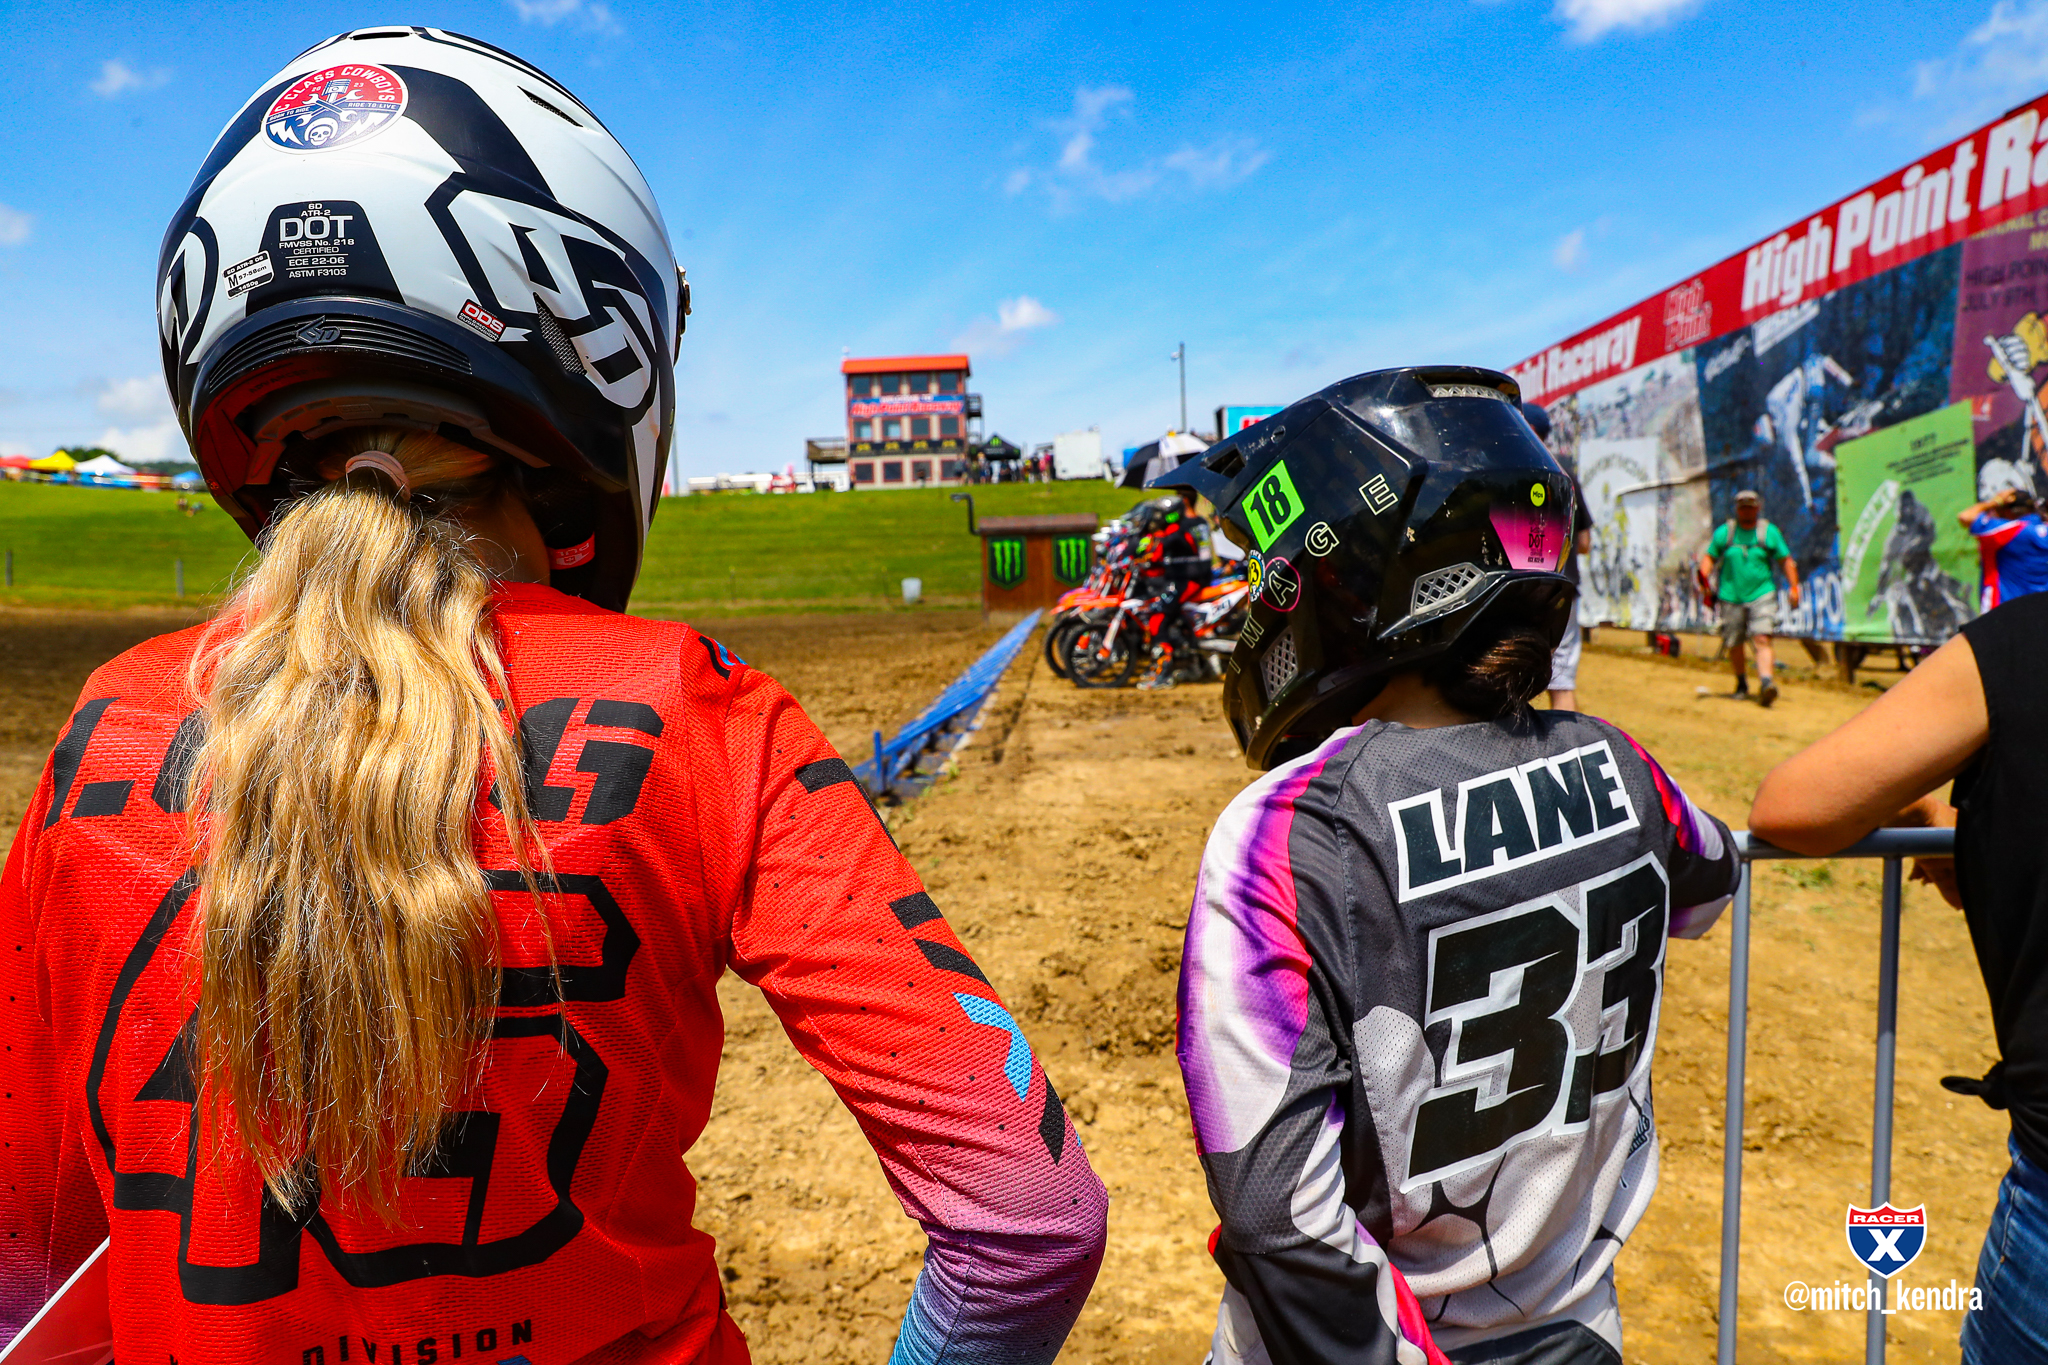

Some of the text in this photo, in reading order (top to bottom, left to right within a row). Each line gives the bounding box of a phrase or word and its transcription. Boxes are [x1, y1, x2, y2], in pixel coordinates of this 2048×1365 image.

[274, 66, 396, 112] C CLASS COWBOYS
[300, 209, 331, 217] ATR-2
[1741, 215, 1832, 312] High
[1832, 140, 1977, 273] Point
[279, 215, 353, 242] DOT
[278, 240, 313, 249] FMVSS
[333, 238, 355, 246] 218
[293, 246, 340, 255] CERTIFIED
[288, 257, 345, 266] ECE 22-06
[288, 268, 347, 278] ASTM F3103
[228, 274, 239, 288] M
[464, 303, 504, 333] ODS
[1508, 353, 1546, 402] oint
[1546, 314, 1642, 393] Raceway
[1249, 474, 1292, 536] 18
[1528, 533, 1545, 548] DOT
[1395, 745, 1633, 893] LANE
[1405, 857, 1670, 1183] 33
[302, 1319, 533, 1365] DIVISION
